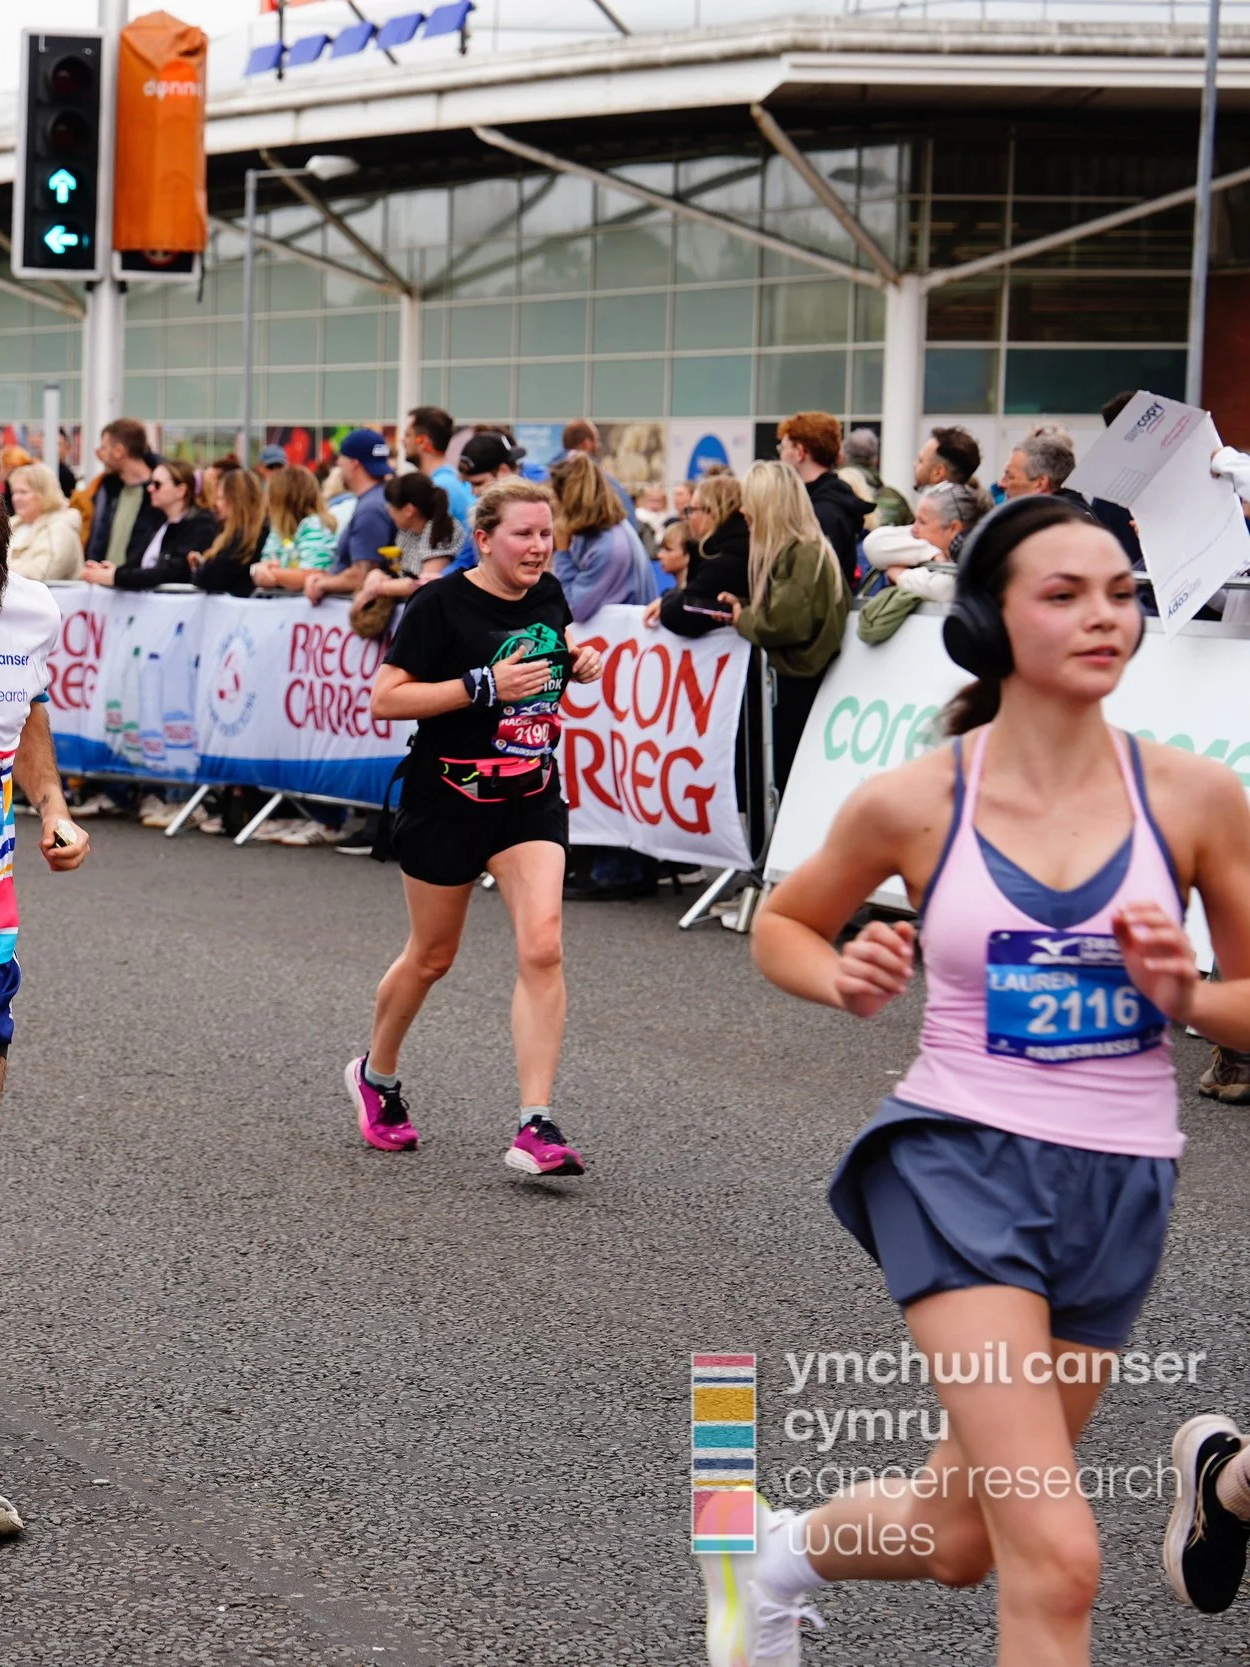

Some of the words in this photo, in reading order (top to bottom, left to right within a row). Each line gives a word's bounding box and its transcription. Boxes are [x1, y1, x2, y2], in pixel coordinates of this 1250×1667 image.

[289, 623, 394, 681] BRECO
[550, 664, 564, 679] RT
[989, 972, 1078, 992] LAUREN
[1026, 986, 1140, 1034] 2116
